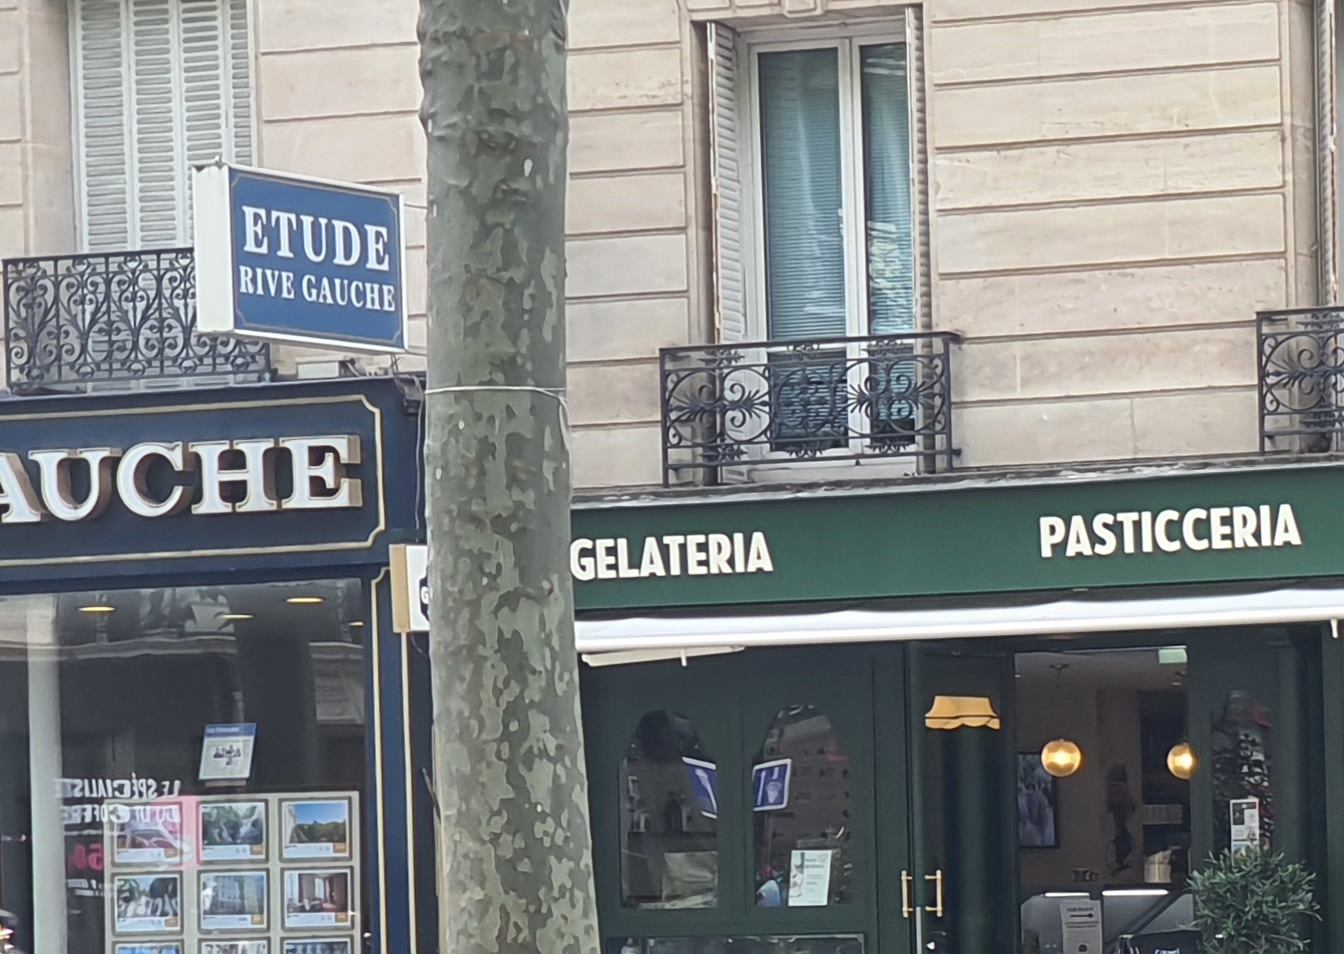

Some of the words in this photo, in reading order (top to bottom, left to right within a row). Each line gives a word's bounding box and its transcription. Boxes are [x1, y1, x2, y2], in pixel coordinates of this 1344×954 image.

[241, 205, 390, 272] ETUDE
[239, 264, 295, 300] RIVE
[302, 274, 396, 312] GAUCHE
[569, 531, 774, 581] GELATERIA
[1039, 503, 1302, 558] PASTICCERIA
